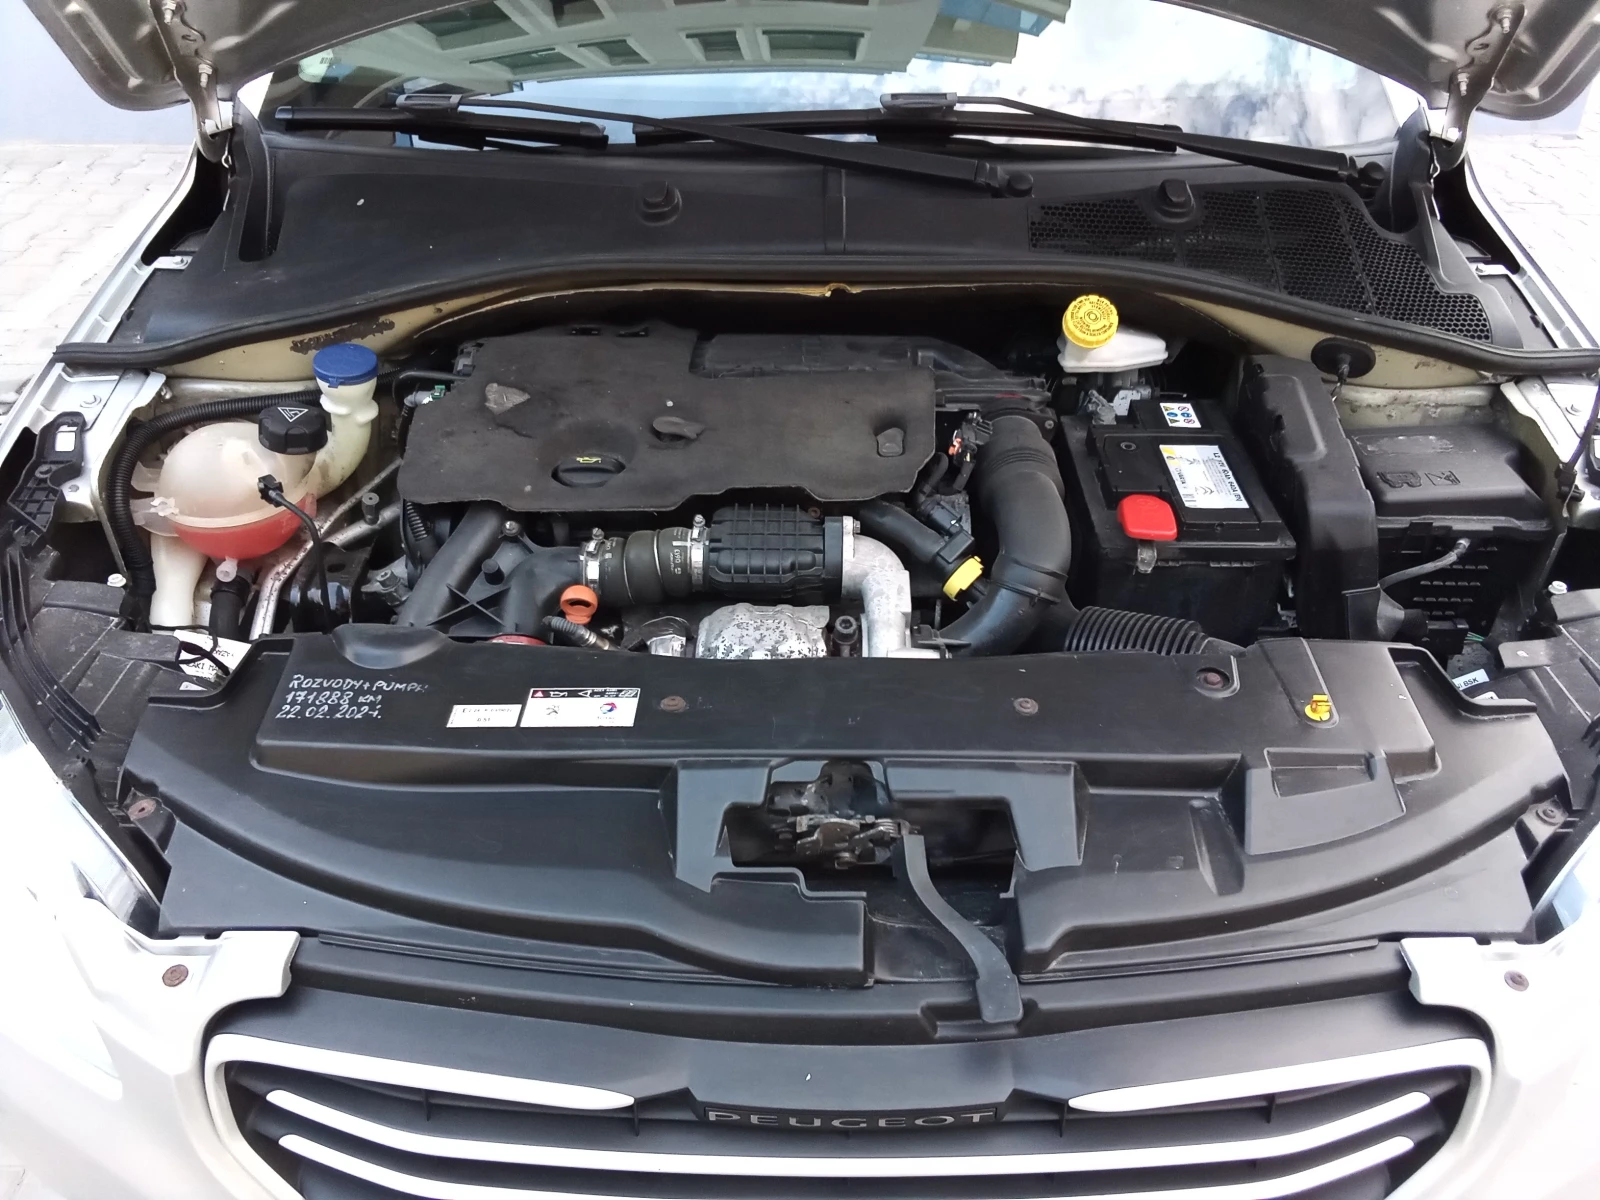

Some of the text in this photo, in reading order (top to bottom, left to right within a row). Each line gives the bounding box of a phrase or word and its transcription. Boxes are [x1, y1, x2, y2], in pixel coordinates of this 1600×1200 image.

[1463, 677, 1479, 687] BSK
[286, 691, 354, 705] 171888
[708, 1110, 994, 1128] PEUGEOT
